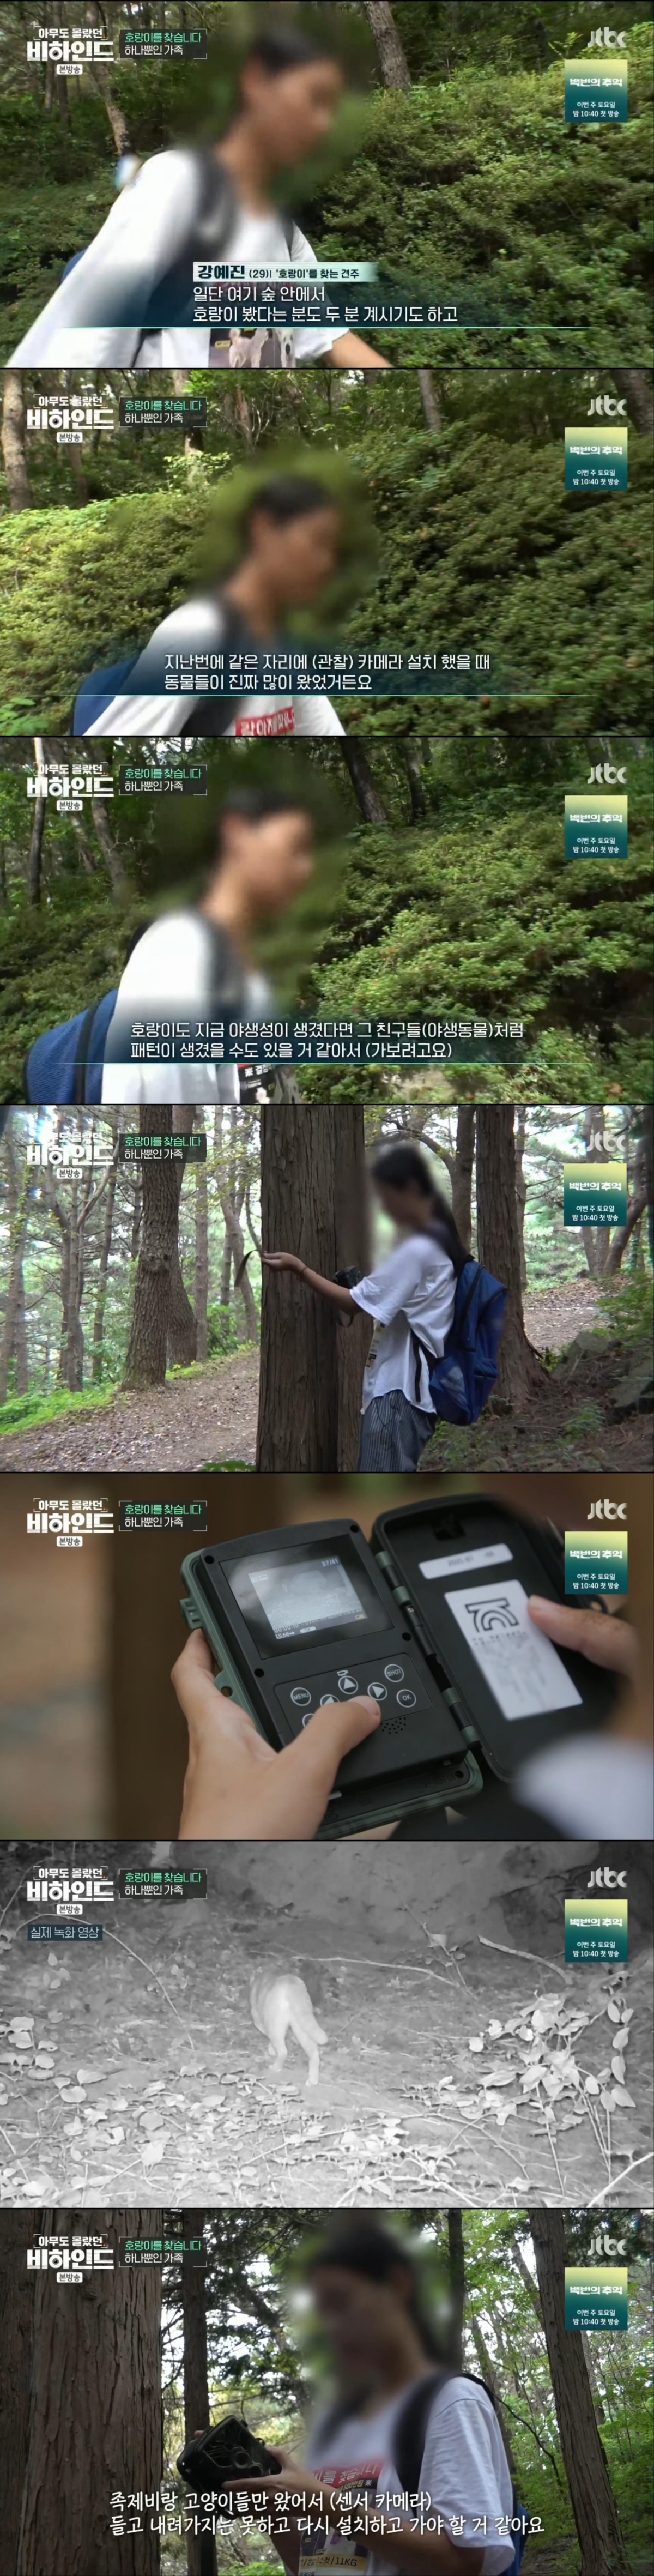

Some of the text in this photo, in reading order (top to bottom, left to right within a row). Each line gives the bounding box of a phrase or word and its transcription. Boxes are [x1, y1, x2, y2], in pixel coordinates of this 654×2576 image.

[321, 1558, 339, 1567] 37/41
[387, 1668, 402, 1678] SHOT
[293, 1692, 310, 1701] MENU
